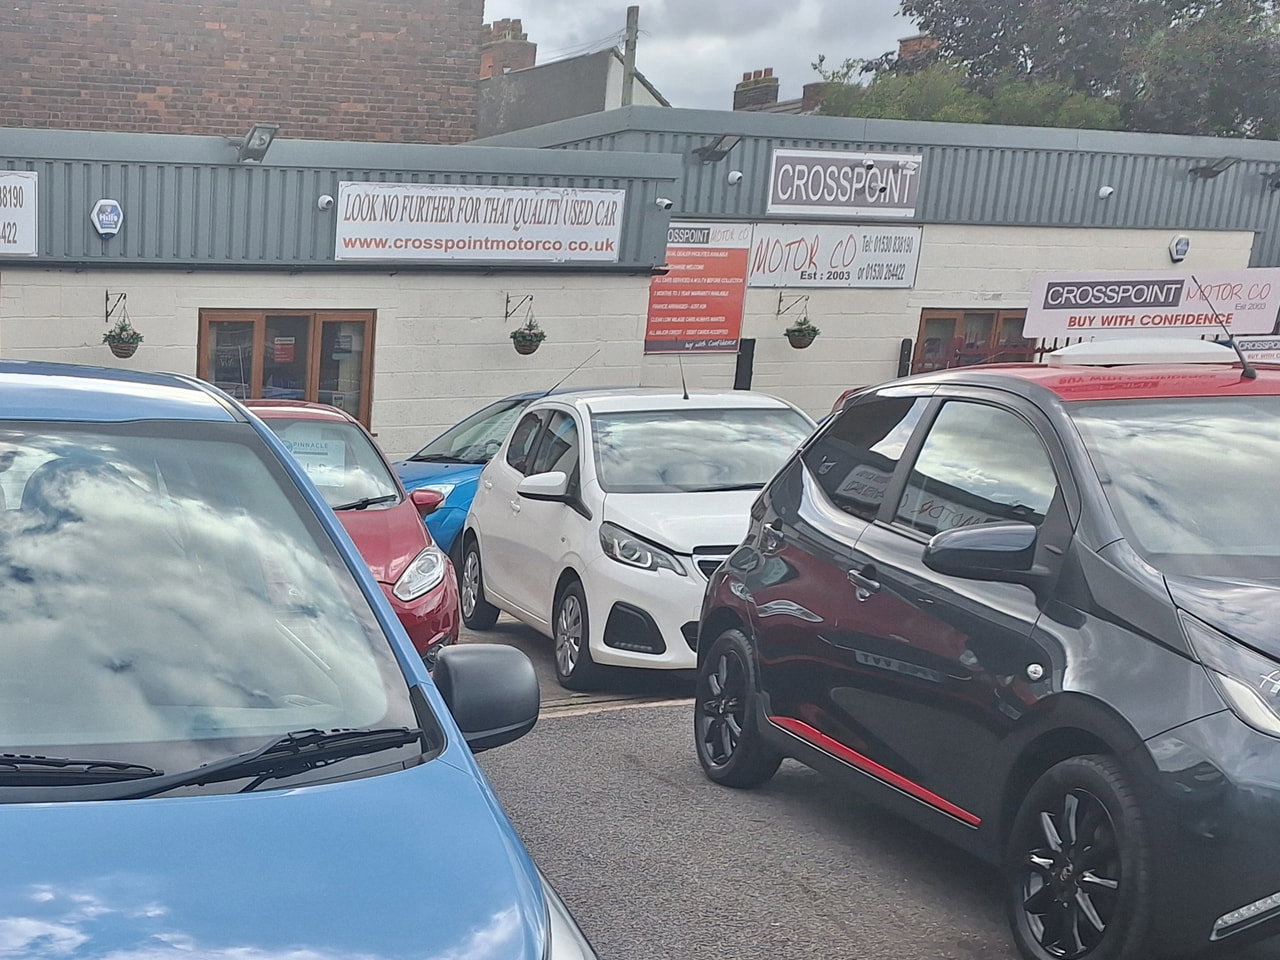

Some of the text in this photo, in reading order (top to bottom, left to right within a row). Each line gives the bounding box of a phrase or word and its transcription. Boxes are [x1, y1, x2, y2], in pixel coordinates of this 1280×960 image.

[777, 163, 916, 204] CROSSPOINT
[344, 193, 618, 231] LOOK NO FURTHER FOR THAT QUALITY USED CAR
[342, 235, 615, 253] www.crosspointmotorco.co.uk
[874, 235, 892, 253] 01530
[750, 233, 857, 277] MOTOR CO
[800, 271, 819, 281] Est
[826, 271, 851, 281] 2003
[865, 263, 884, 280] 01530
[1047, 282, 1271, 305] CROSSPOINT MOTOR CO
[1067, 312, 1234, 328] BUY WITH CONFIDENCE
[293, 441, 328, 449] PINNACLE
